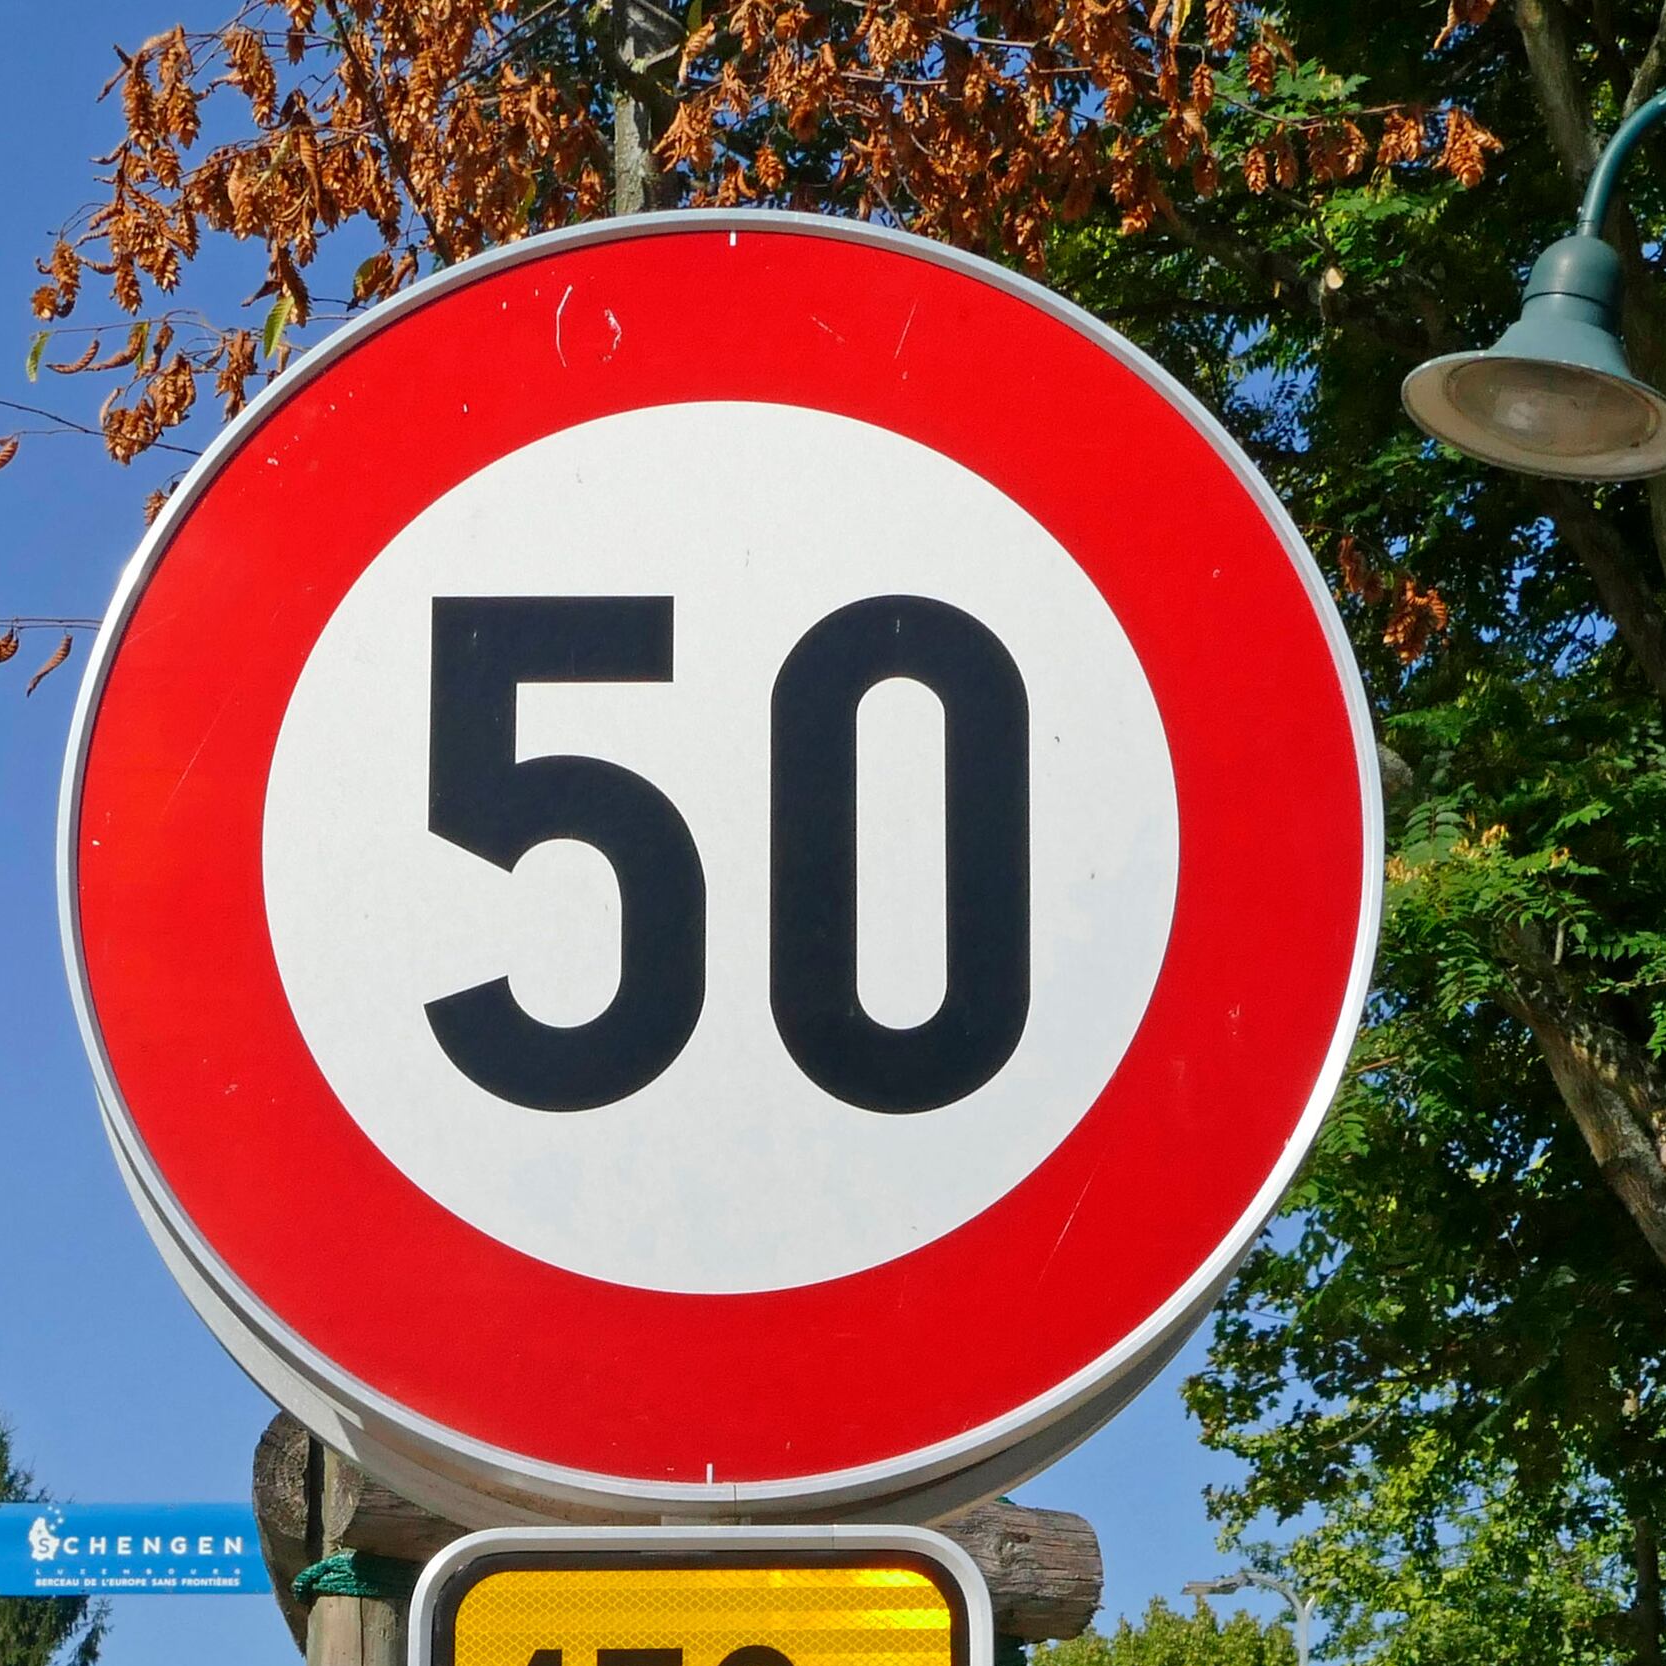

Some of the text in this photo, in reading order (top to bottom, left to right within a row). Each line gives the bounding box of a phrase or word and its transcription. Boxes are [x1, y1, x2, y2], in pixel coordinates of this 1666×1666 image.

[424, 594, 1031, 1115] 50
[39, 1537, 243, 1555] SCHENGEN
[36, 1577, 79, 1587] BERCEAU
[84, 1577, 96, 1587] DE
[102, 1577, 147, 1587] L'EUROPE
[152, 1577, 177, 1587] SANS
